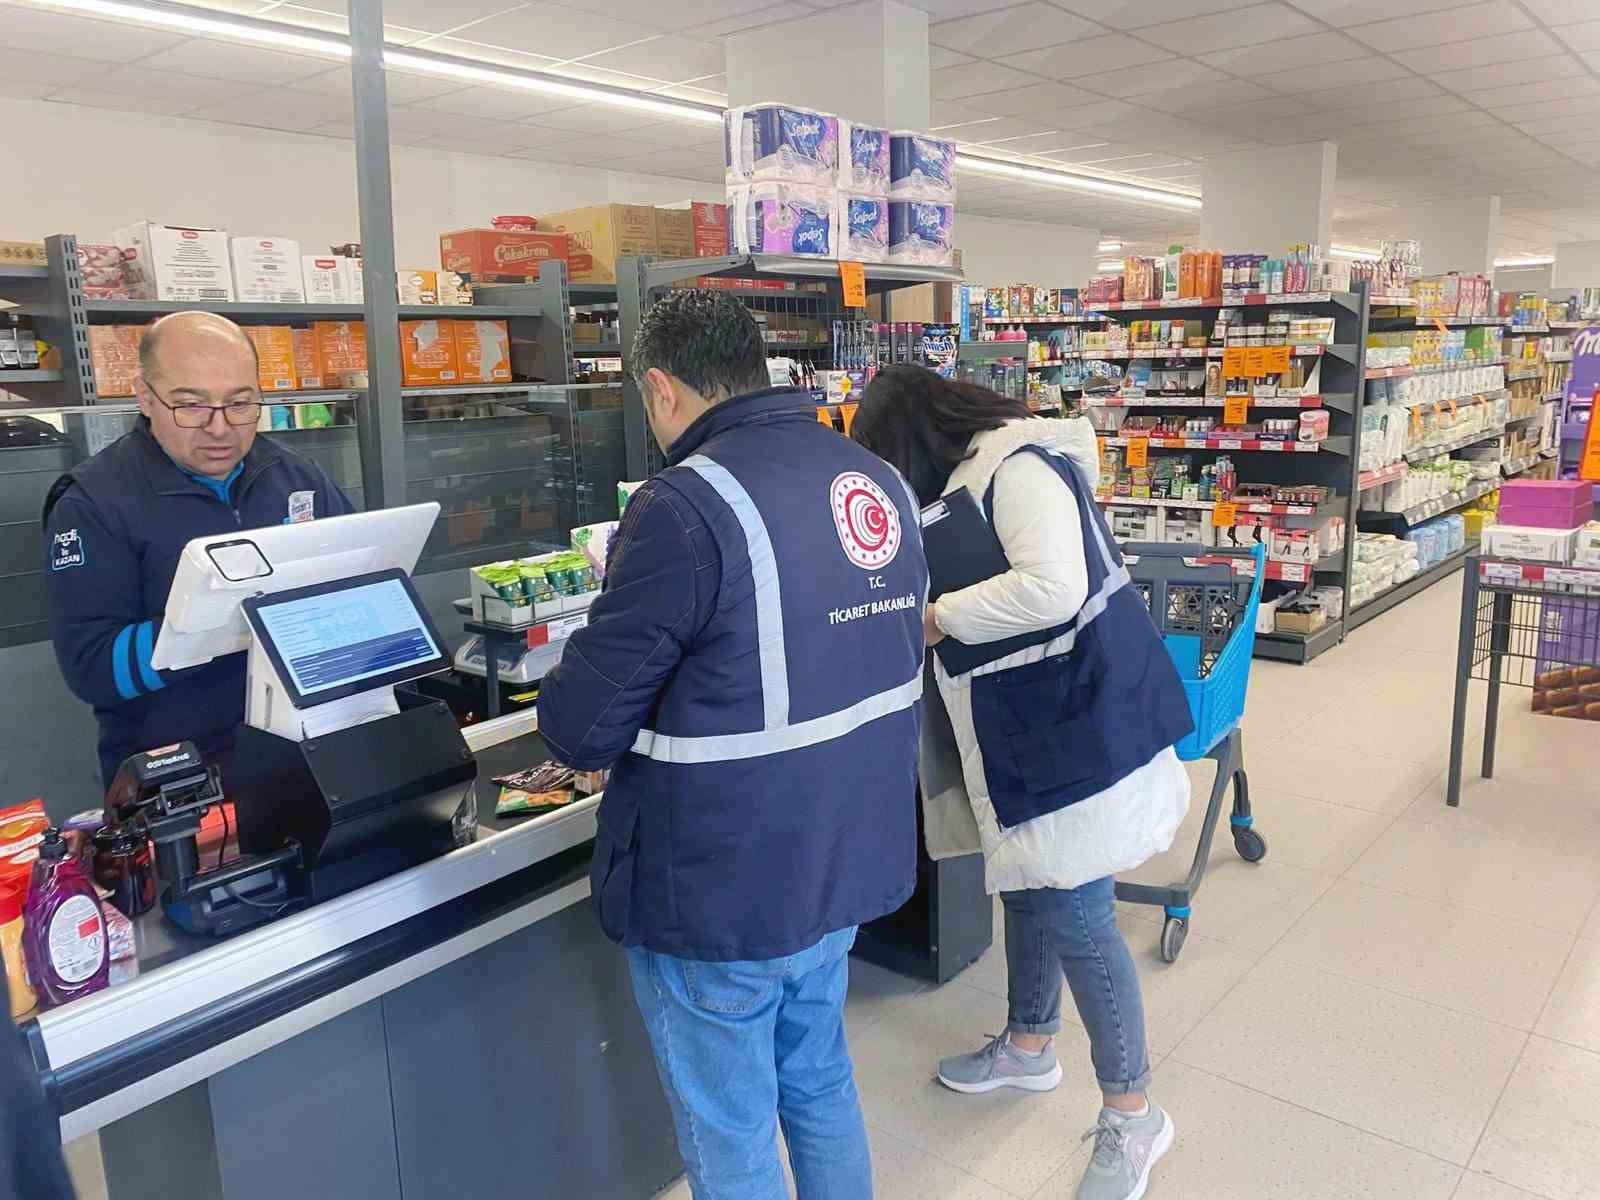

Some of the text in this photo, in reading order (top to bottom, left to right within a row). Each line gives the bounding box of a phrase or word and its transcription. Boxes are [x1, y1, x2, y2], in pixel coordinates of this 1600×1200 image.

[853, 208, 878, 226] Selpak
[798, 227, 826, 244] Selpak
[54, 529, 77, 545] hadi
[868, 576, 886, 589] T.C.
[828, 592, 916, 625] TİCARET BAKANLIĞI
